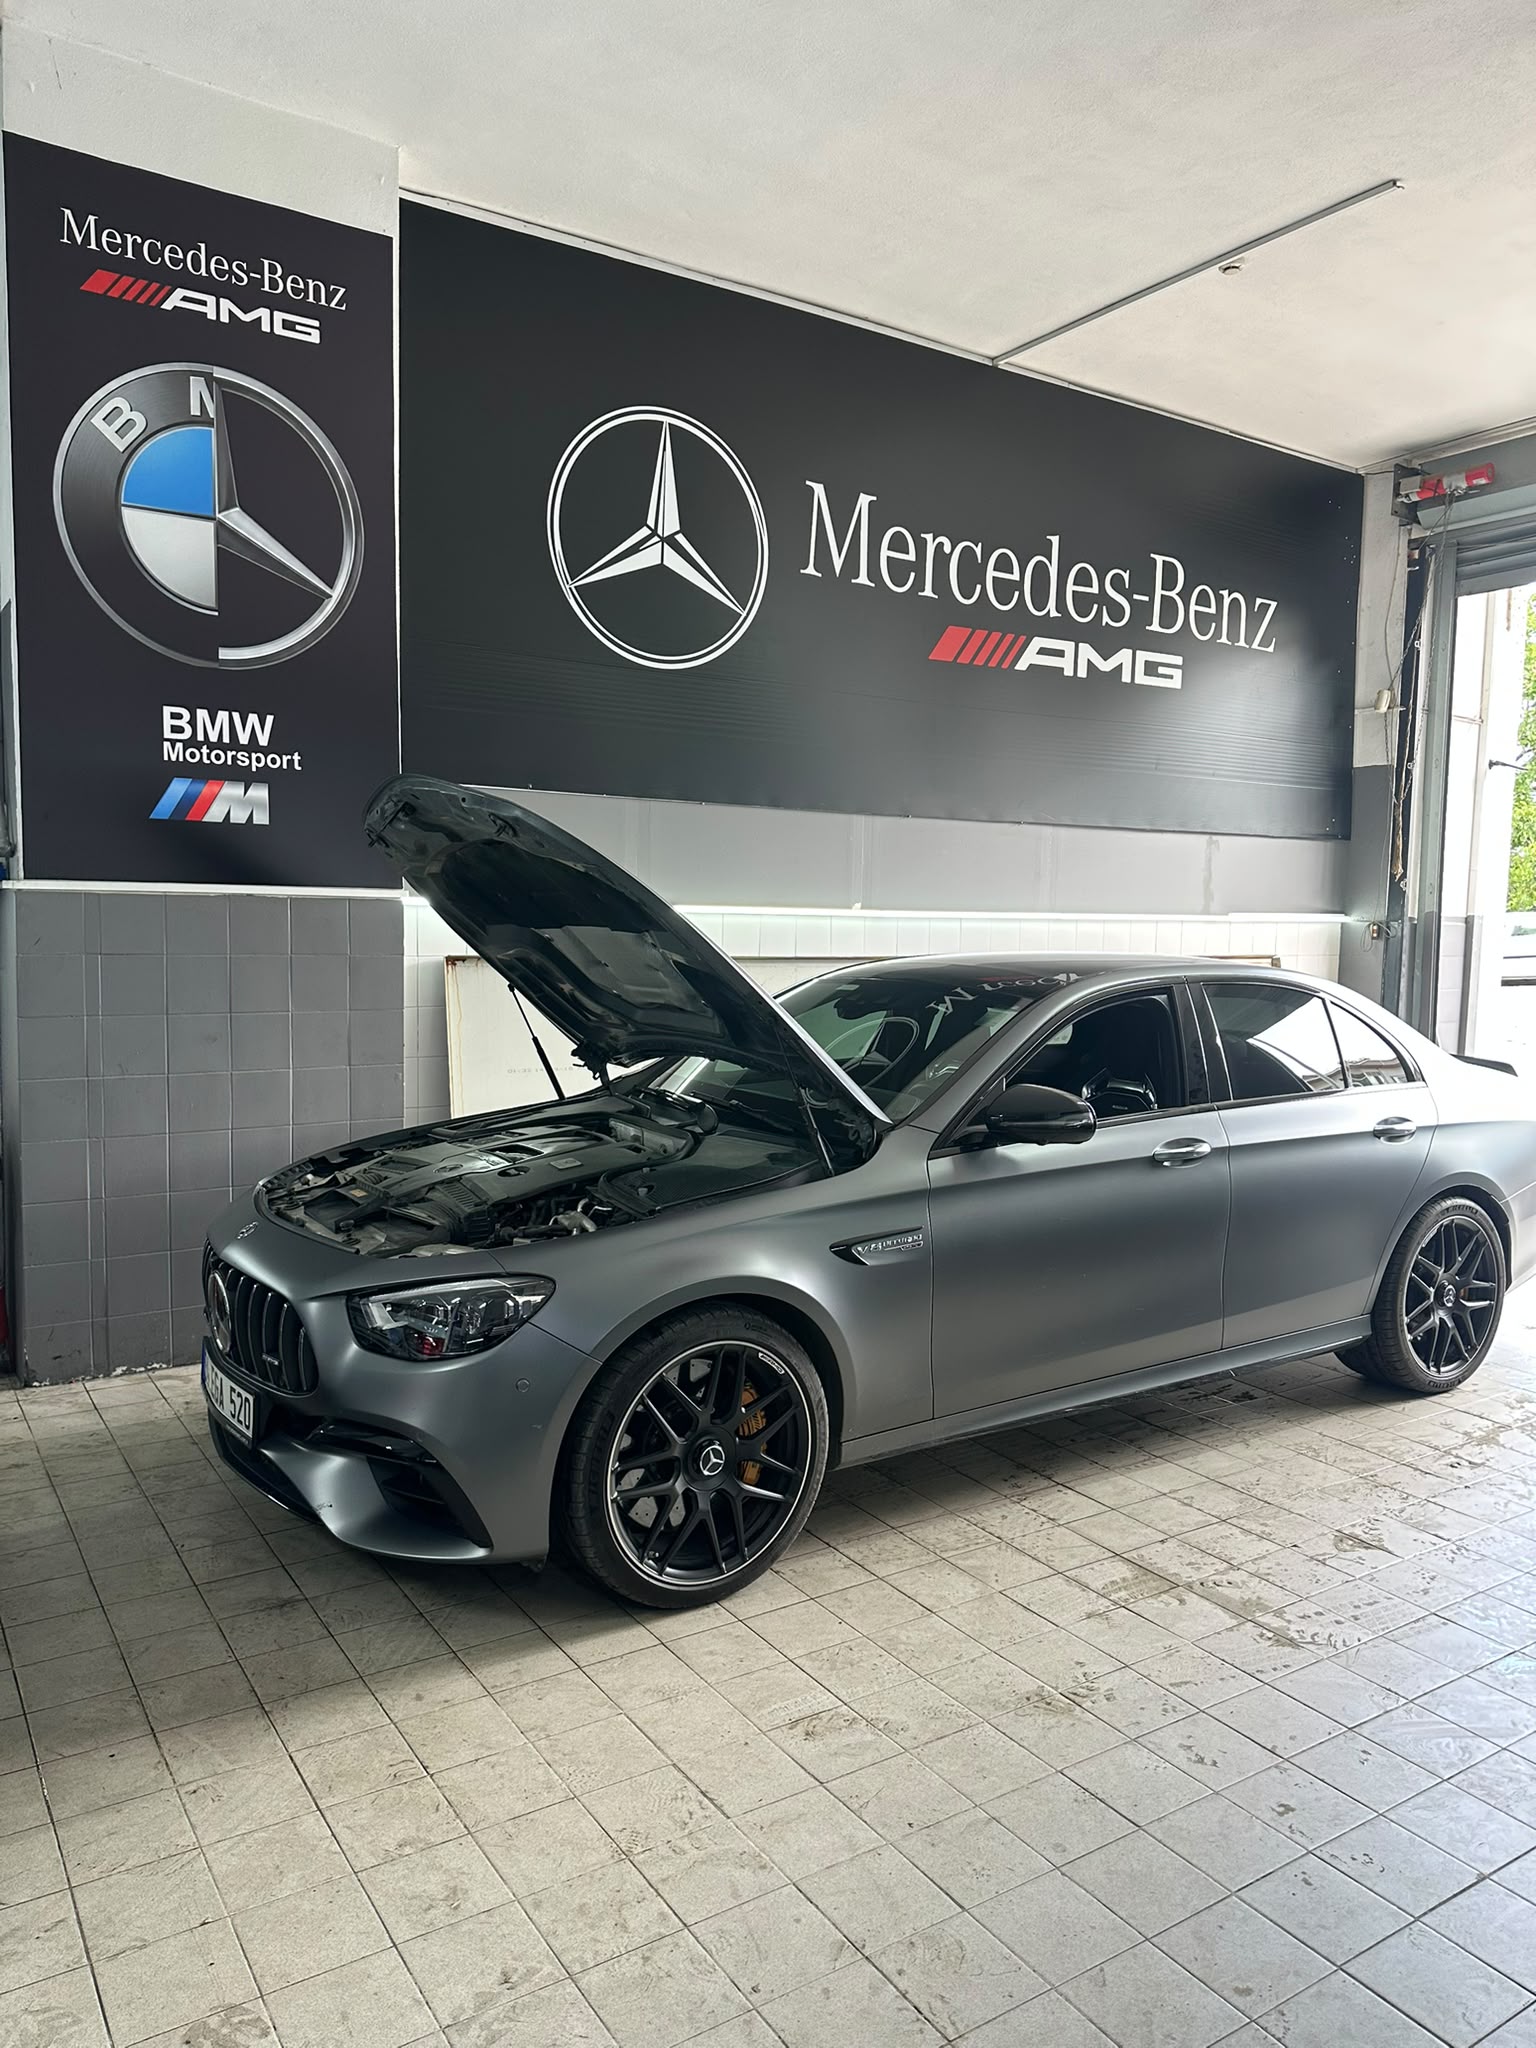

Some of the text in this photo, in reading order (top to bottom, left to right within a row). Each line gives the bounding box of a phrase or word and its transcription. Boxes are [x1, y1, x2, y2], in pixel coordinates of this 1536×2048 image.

[60, 207, 347, 311] Mercedes-Benz
[160, 287, 320, 344] AMG
[800, 480, 1278, 654] Mercedes-Benz
[1014, 636, 1183, 690] AMG
[162, 705, 274, 746] BMW
[163, 741, 302, 771] Motorsport
[229, 1384, 251, 1431] 520
